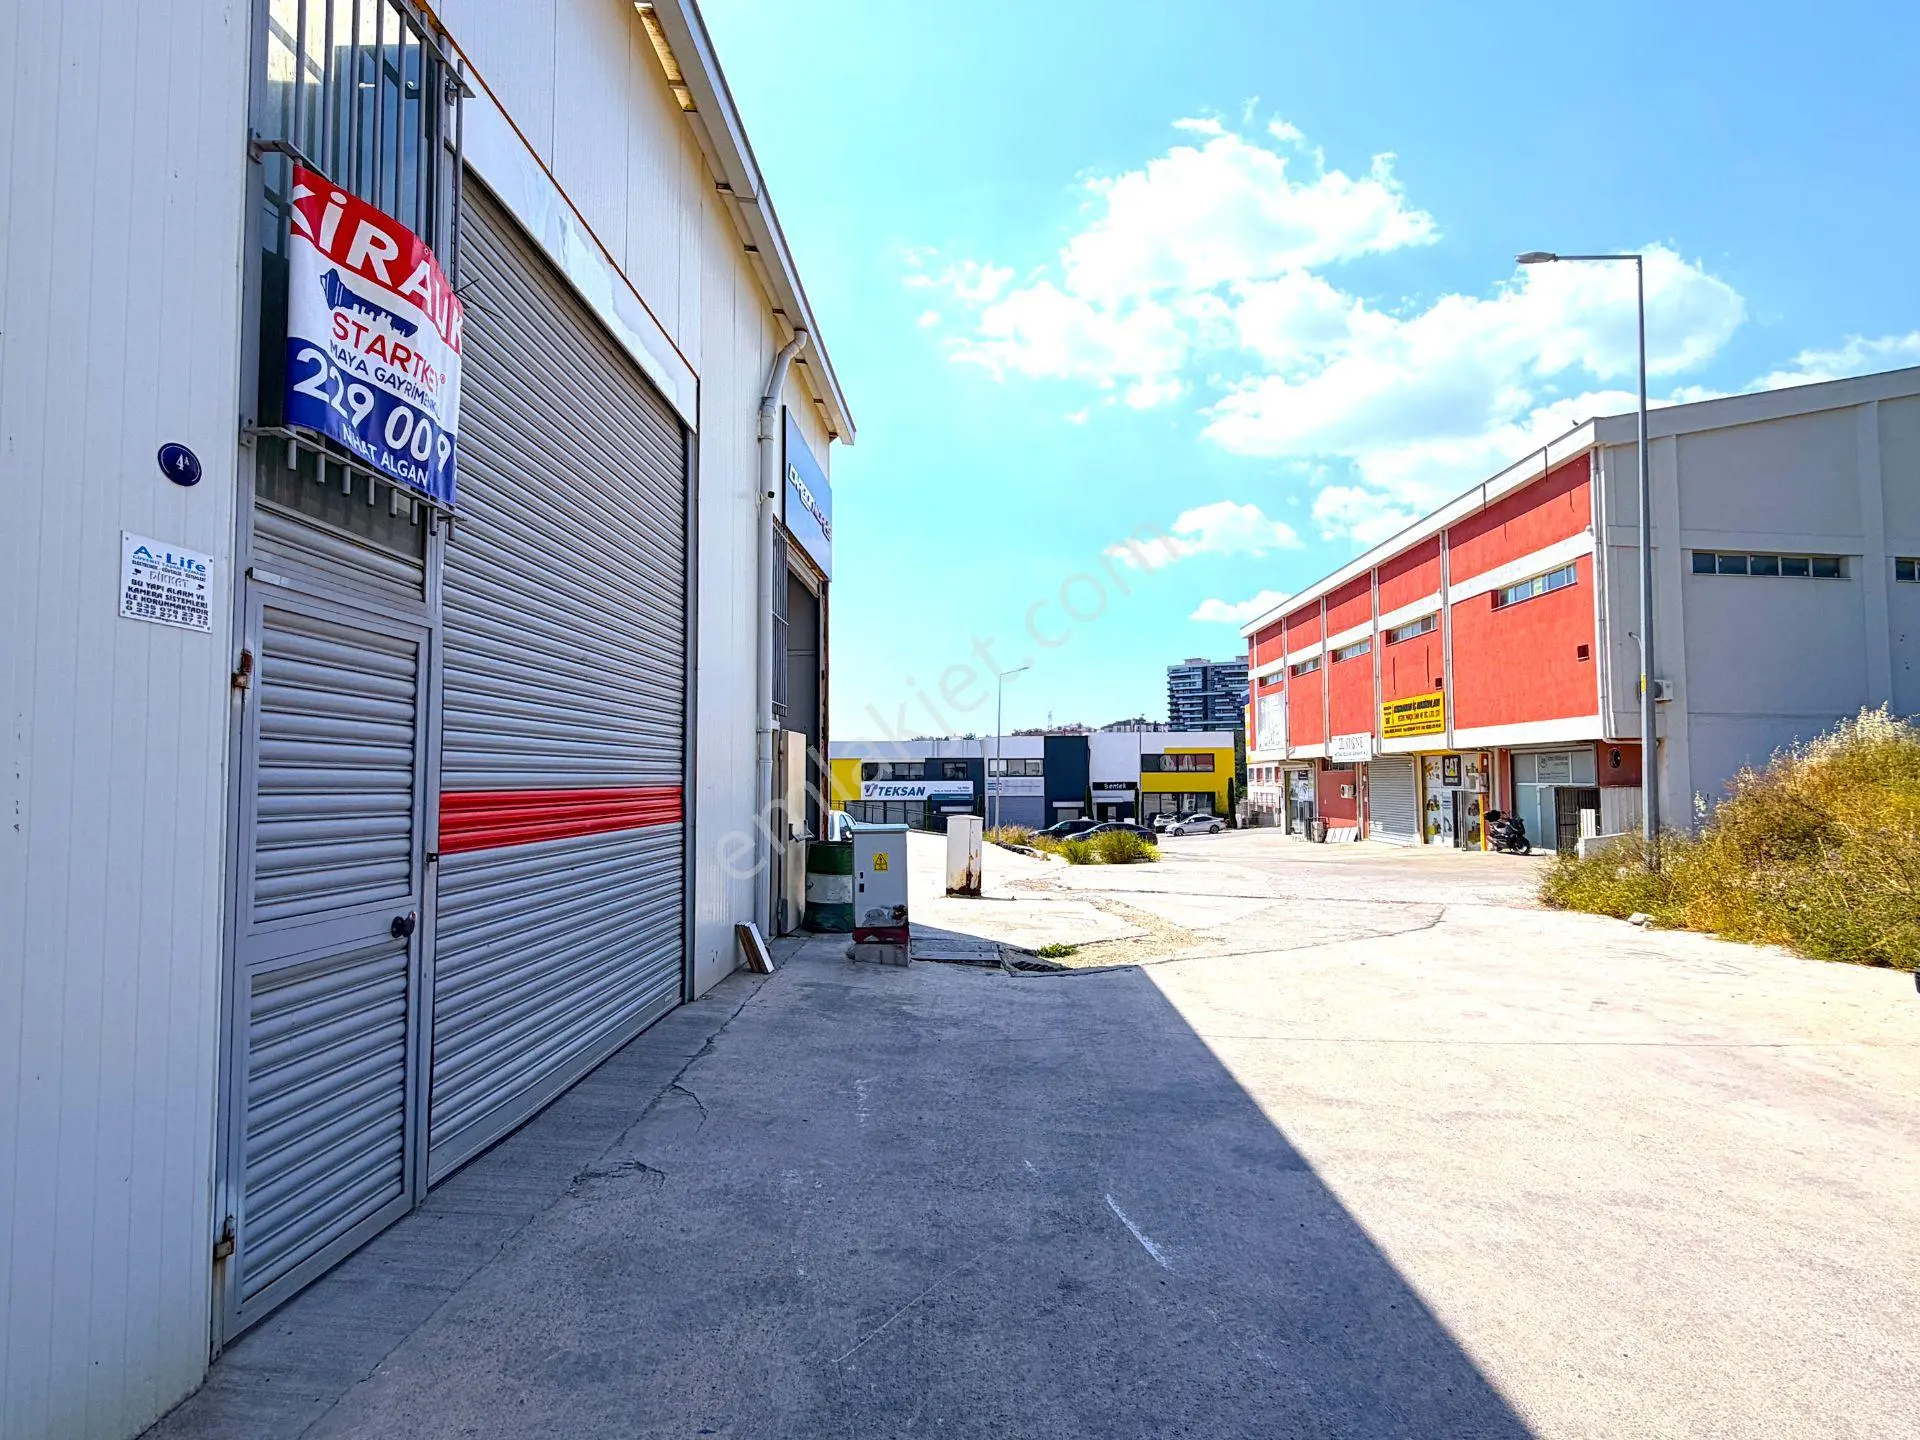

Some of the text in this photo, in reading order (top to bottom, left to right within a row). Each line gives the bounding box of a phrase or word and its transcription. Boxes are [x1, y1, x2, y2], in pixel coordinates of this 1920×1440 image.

[330, 341, 368, 375] MAYA
[294, 348, 375, 428] 229
[381, 452, 429, 487] ALGAN
[133, 546, 206, 573] A-Life
[128, 585, 207, 609] KAMERA SİSTEMLERİ
[131, 578, 142, 586] BU
[146, 582, 164, 591] YAPI
[166, 587, 193, 598] ALARM
[125, 592, 208, 615] İLE KORUNMAKTADIR
[878, 786, 925, 796] TEKSAN
